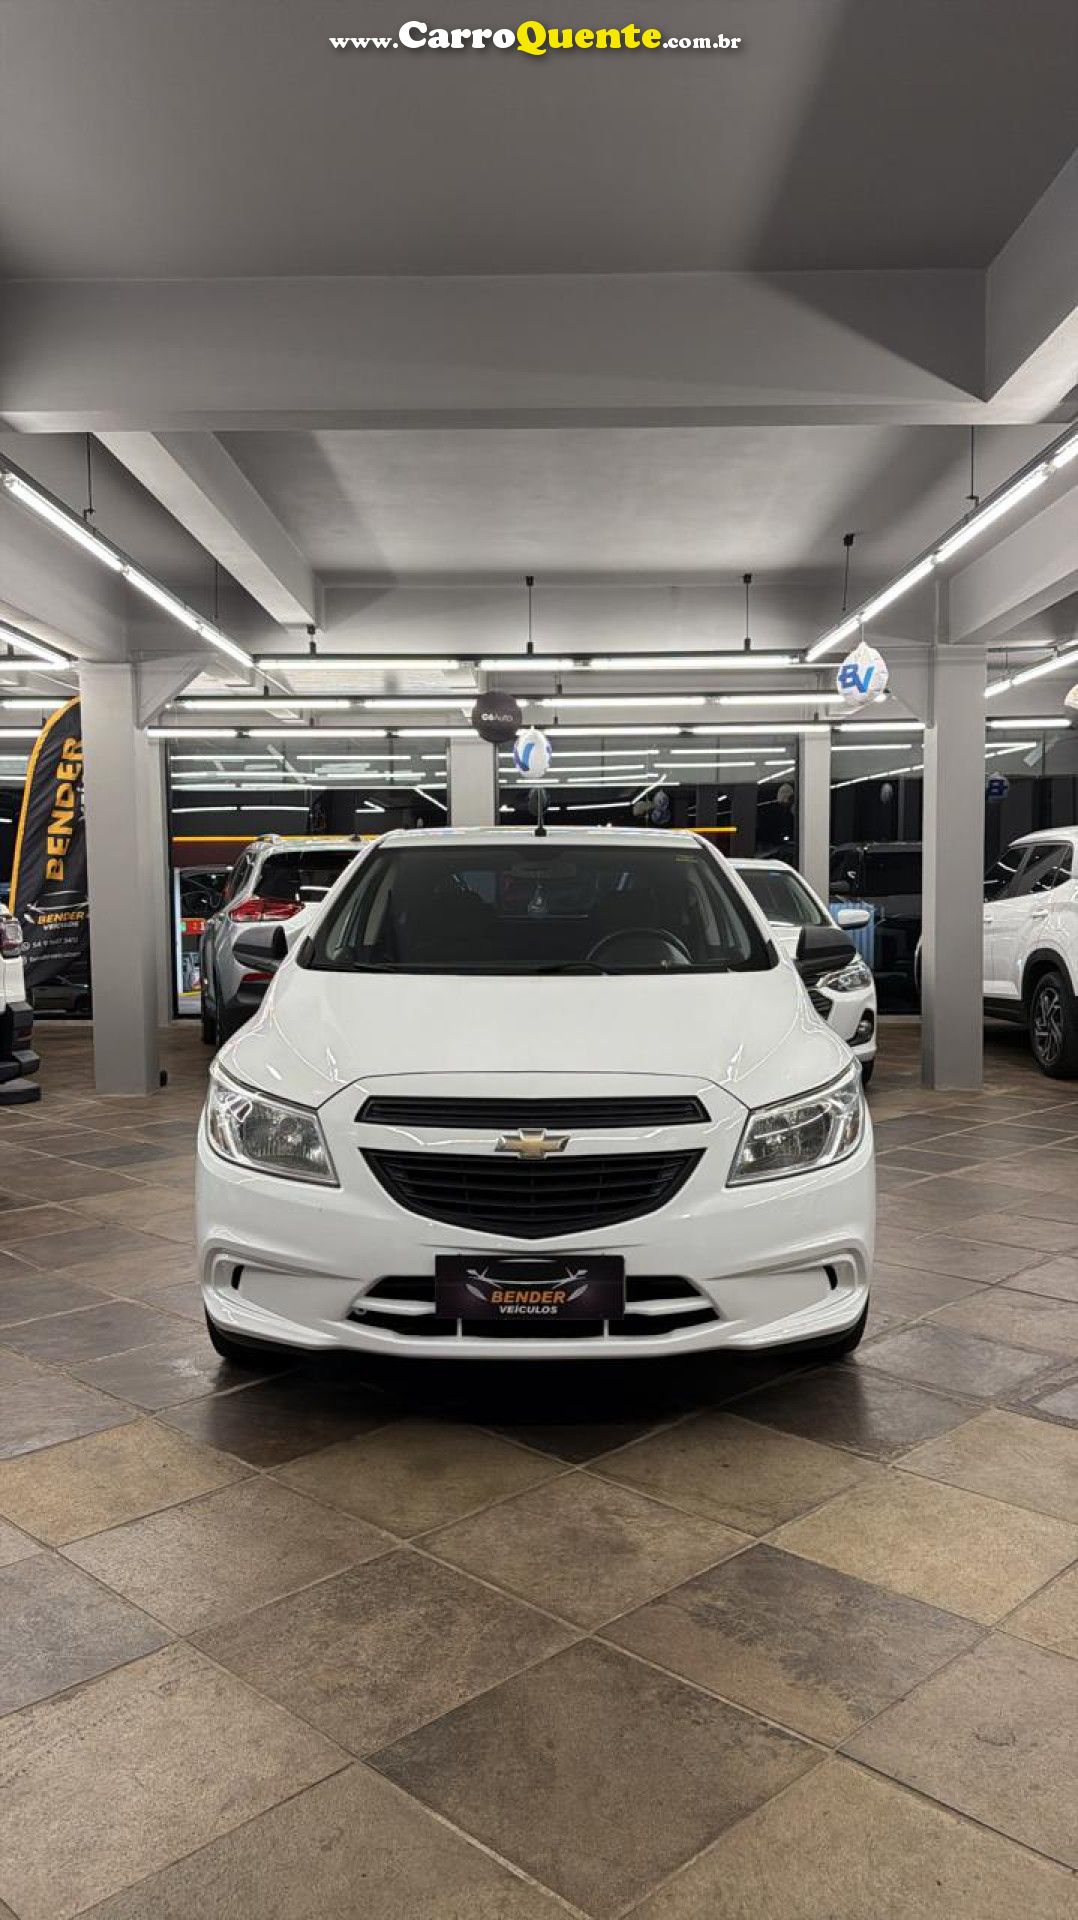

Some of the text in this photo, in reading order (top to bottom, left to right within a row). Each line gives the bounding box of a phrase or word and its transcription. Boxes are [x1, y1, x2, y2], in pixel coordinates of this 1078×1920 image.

[838, 664, 875, 693] BV
[46, 737, 84, 881] BENDER
[491, 1291, 566, 1303] BENDER
[500, 1304, 558, 1315] VEÍCULOS
